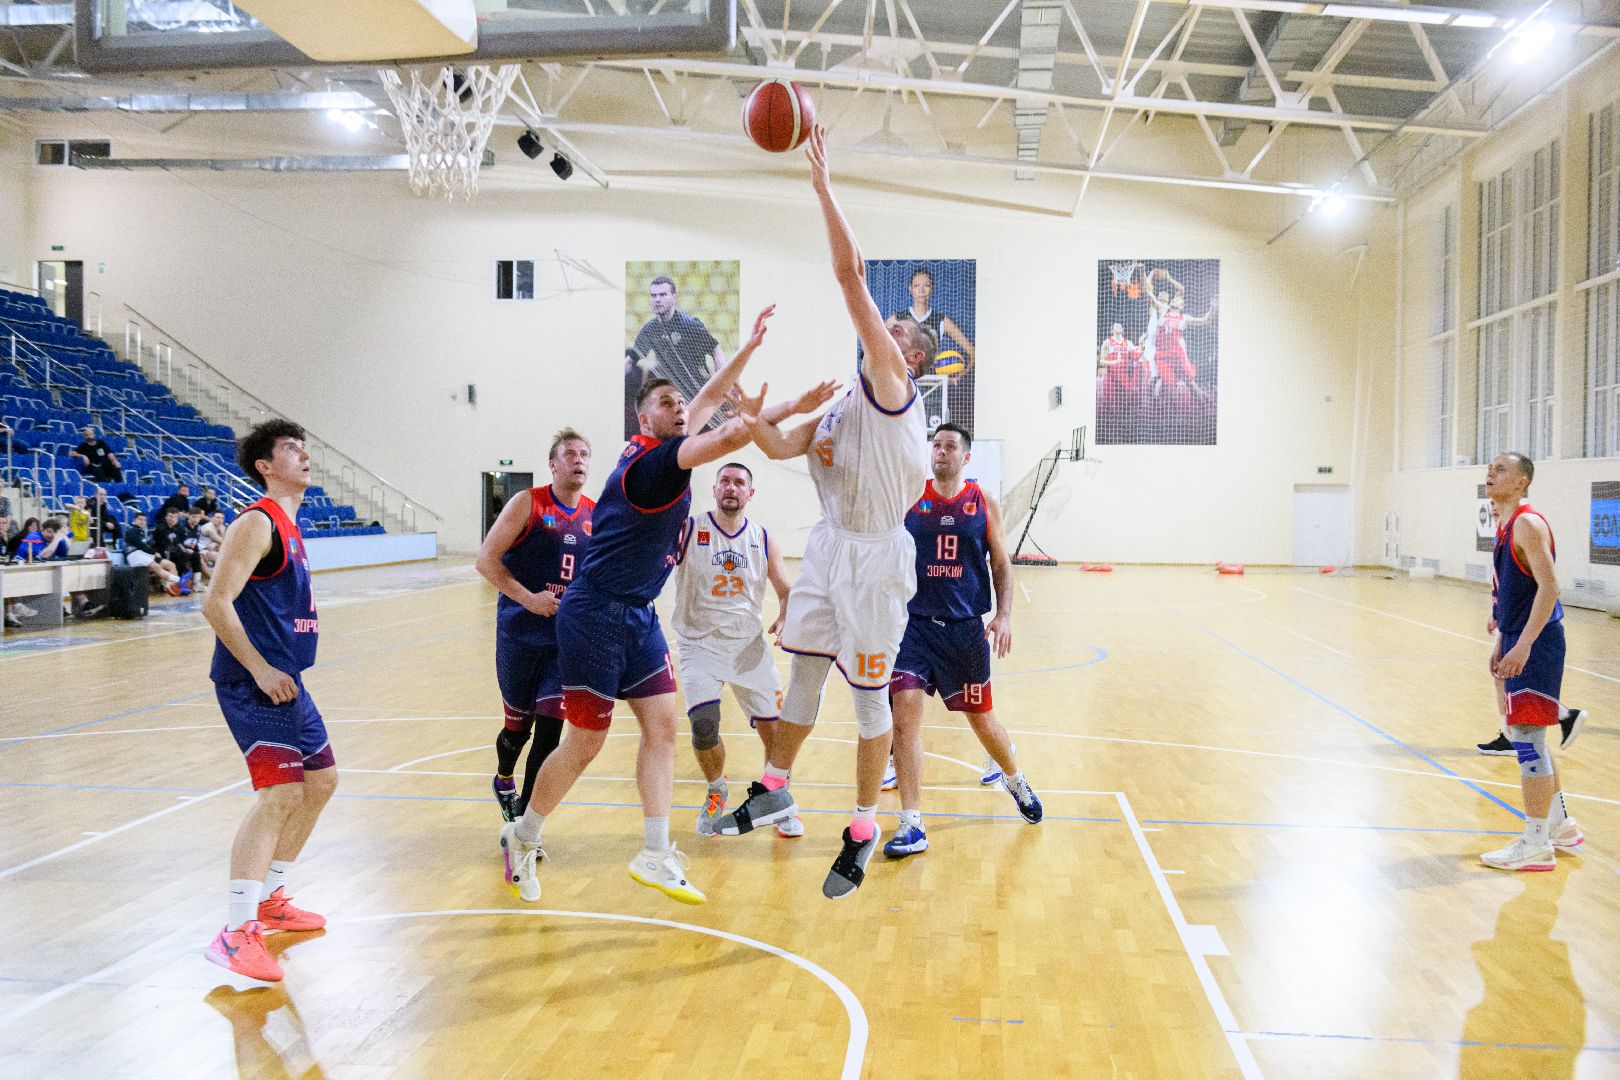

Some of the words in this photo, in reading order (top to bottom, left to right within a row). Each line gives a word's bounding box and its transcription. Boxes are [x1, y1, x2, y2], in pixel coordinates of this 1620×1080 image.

[936, 534, 959, 560] 19
[560, 553, 575, 581] 9
[926, 564, 963, 578] ЗОРКИЙ
[711, 574, 743, 597] 23
[856, 651, 886, 679] 15
[963, 682, 984, 705] 19
